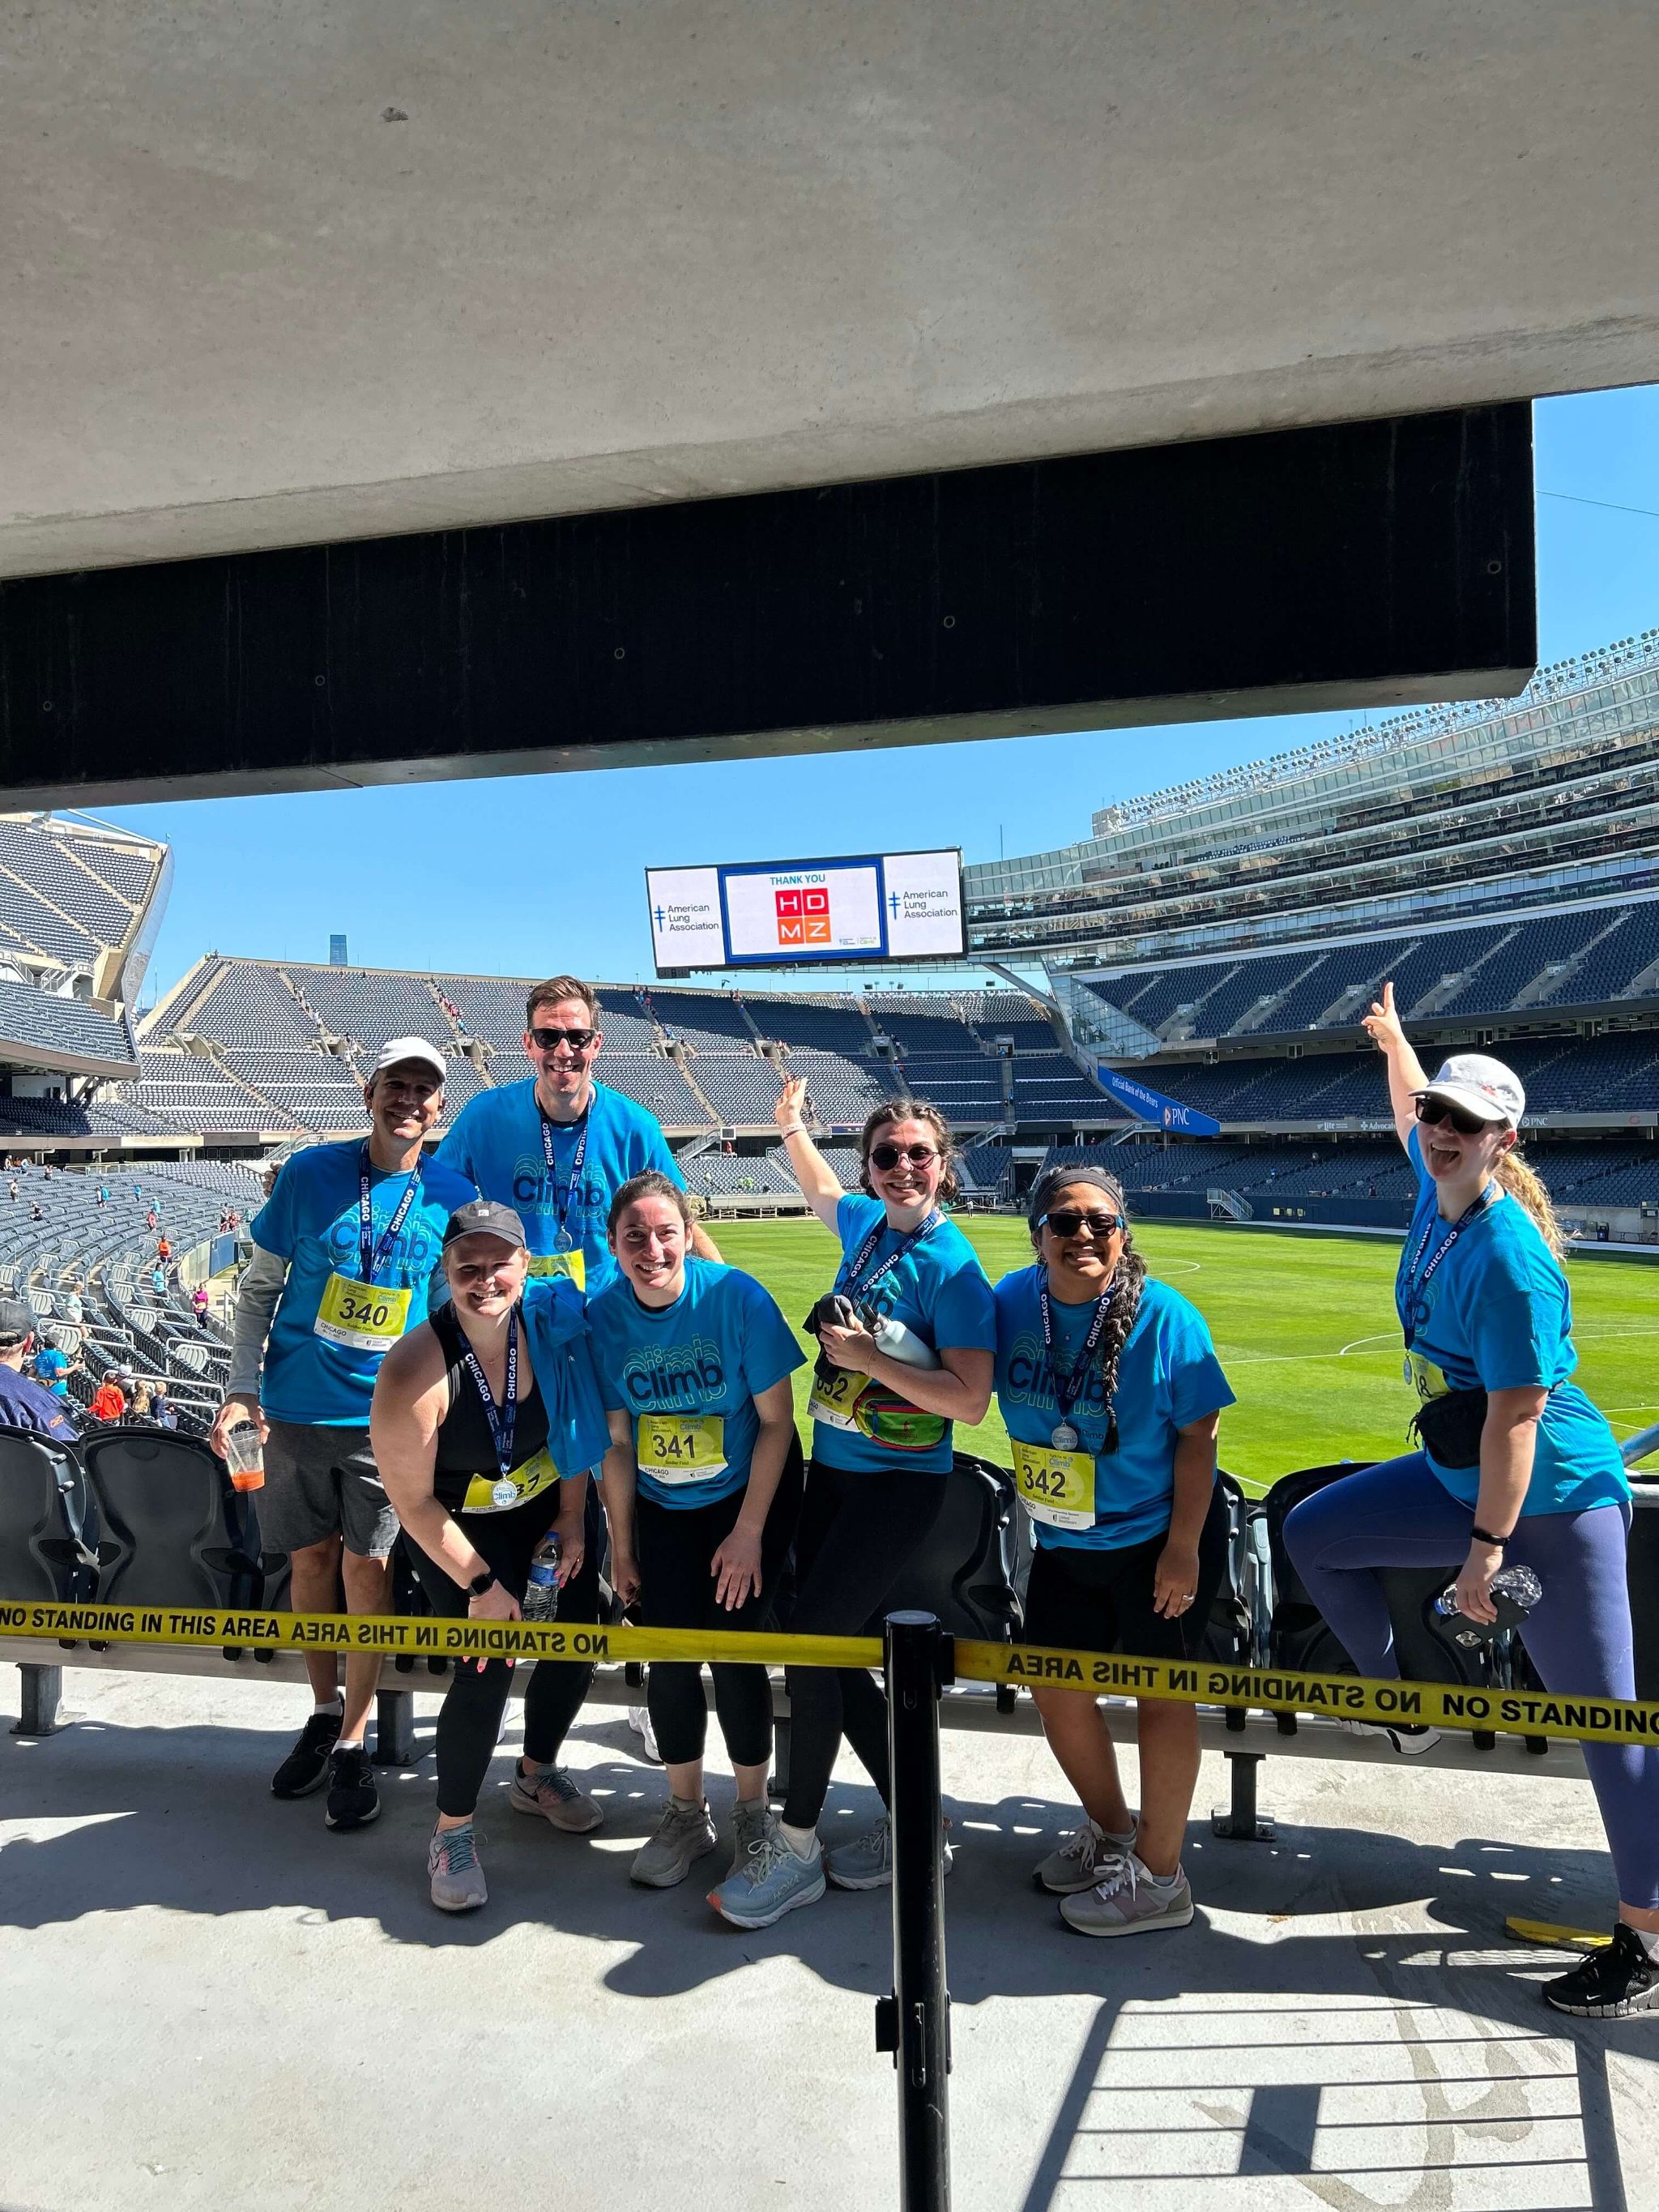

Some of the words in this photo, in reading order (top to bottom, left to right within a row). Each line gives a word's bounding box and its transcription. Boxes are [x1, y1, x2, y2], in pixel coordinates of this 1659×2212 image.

[770, 876, 803, 886] THANK
[804, 873, 825, 883] YOU
[903, 890, 949, 899] American
[904, 901, 927, 910] Lung
[667, 904, 710, 913] American
[668, 914, 690, 923] Lung
[904, 908, 957, 918] Association
[669, 923, 719, 932] Association
[1112, 1076, 1125, 1091] Official
[1125, 1081, 1135, 1095] Bank
[1146, 1092, 1158, 1108] Bears
[1171, 1108, 1190, 1125] PNC
[1531, 1117, 1548, 1125] PNC
[542, 1122, 554, 1165] CHICAGO
[360, 1176, 371, 1222] CHICAGO
[390, 1189, 414, 1232] CHICAGO
[851, 1236, 877, 1277] CHICAGO
[1424, 1231, 1458, 1279] CHICAGO
[863, 1254, 898, 1291] CHICAGO
[339, 1297, 389, 1326] 340
[1041, 1294, 1051, 1344] CHICAGO
[1087, 1296, 1111, 1347] CHICAGO
[320, 1322, 347, 1337] CHICAGO
[465, 1352, 491, 1402] CHICAGO
[508, 1347, 517, 1400] CHICAGO
[626, 1360, 723, 1400] Climb
[652, 1435, 695, 1458] 341
[645, 1467, 669, 1475] CHICAGO
[1049, 1458, 1071, 1467] Climb
[1022, 1464, 1066, 1498] 342
[493, 1492, 516, 1501] Climb
[0, 1608, 26, 1626] NO
[32, 1609, 134, 1632] STANDING
[141, 1613, 163, 1633] IN
[168, 1614, 216, 1636] THIS
[221, 1616, 280, 1638] AREA
[1443, 1693, 1491, 1719] NO
